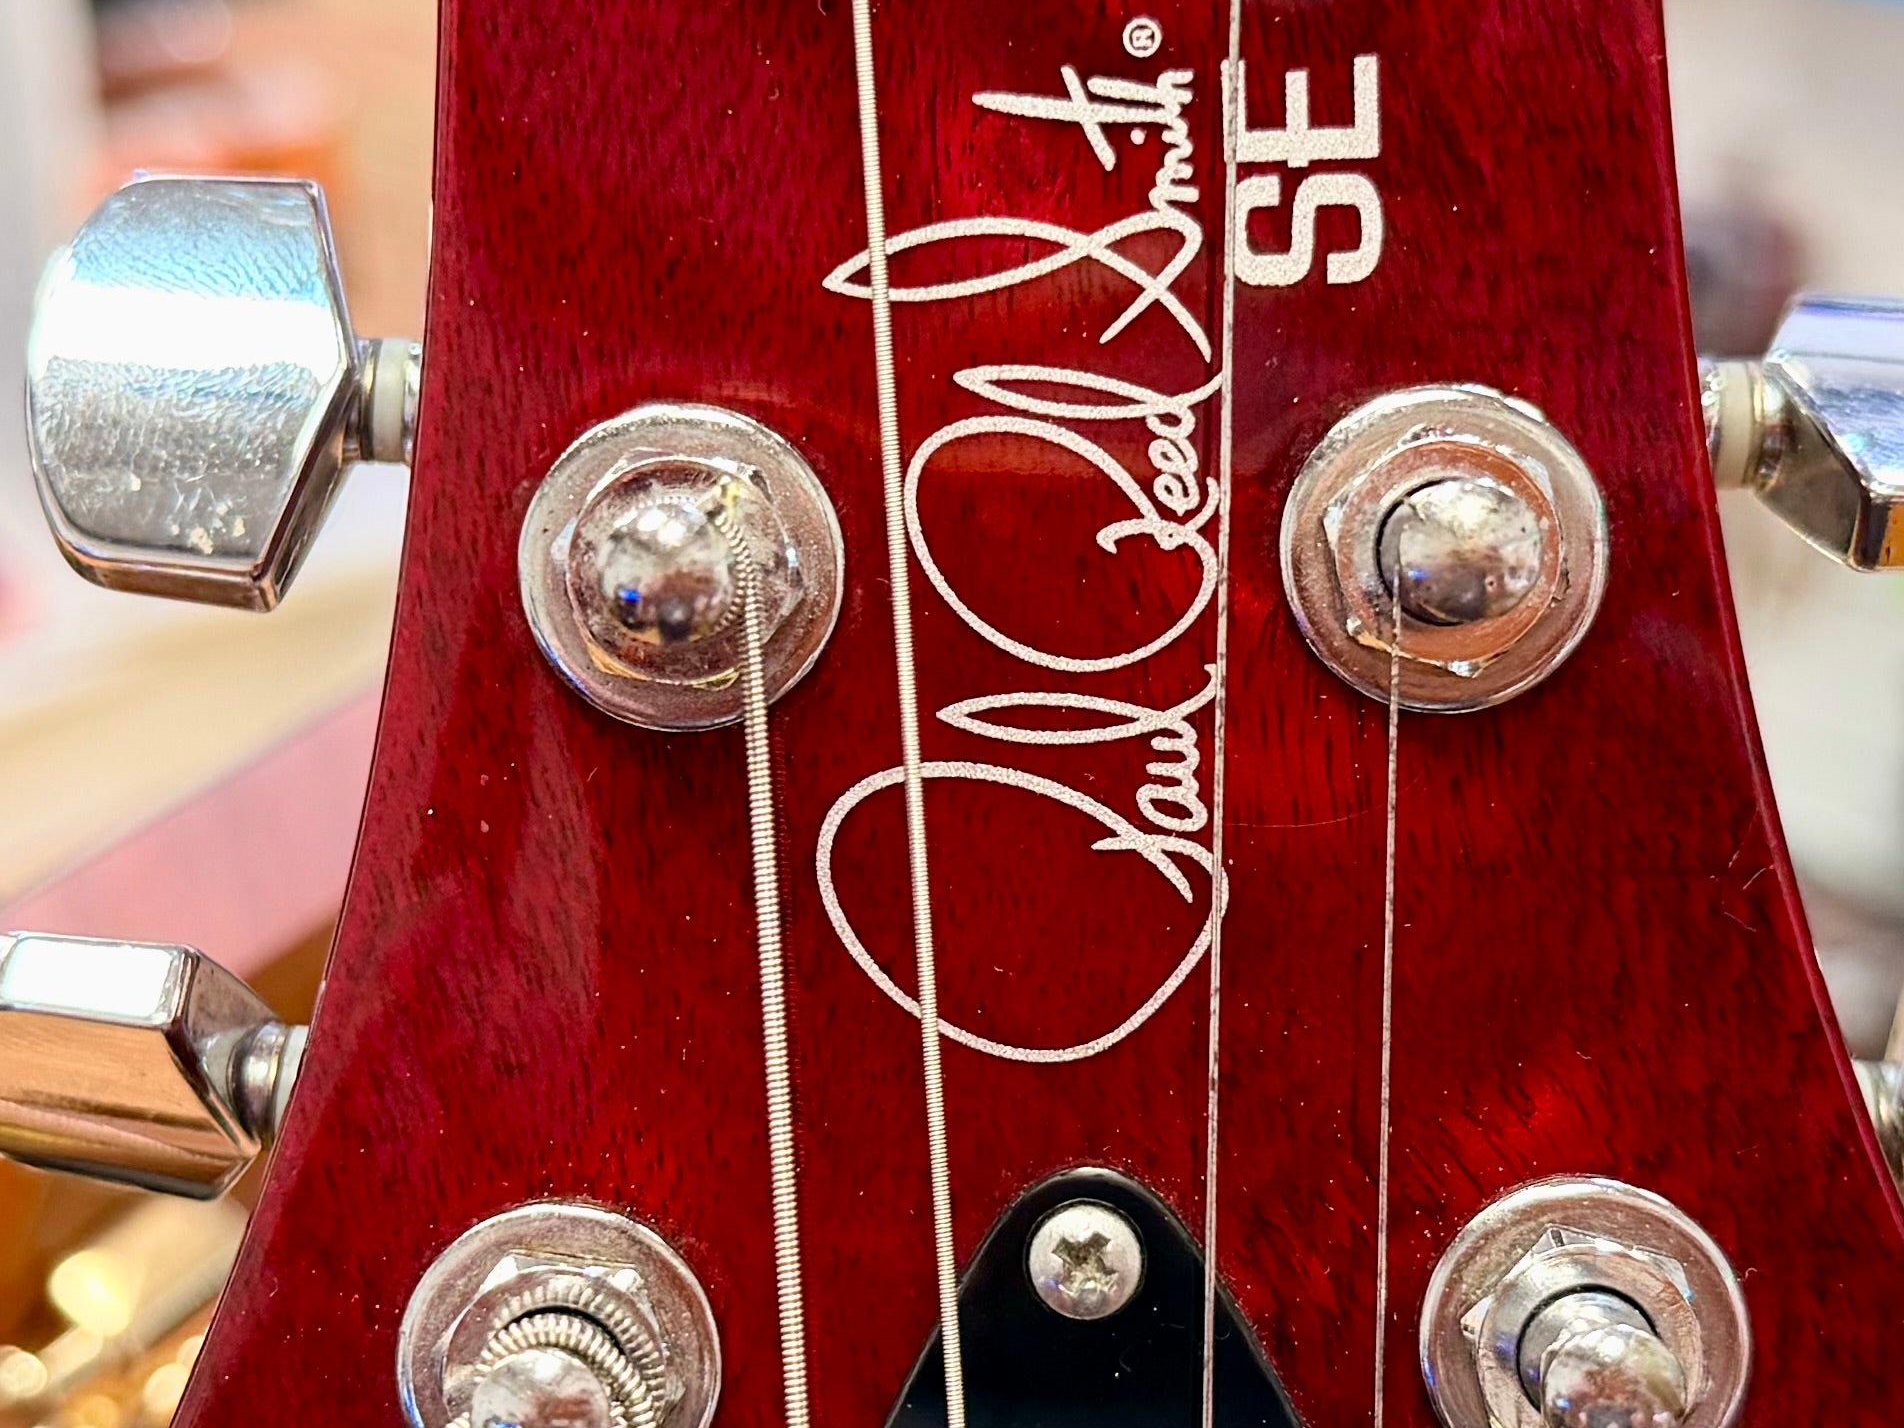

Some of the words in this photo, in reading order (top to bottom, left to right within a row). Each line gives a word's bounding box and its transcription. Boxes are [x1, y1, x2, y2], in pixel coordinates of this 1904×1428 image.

[1220, 52, 1384, 287] SE
[904, 364, 1224, 673] Reed
[815, 663, 1230, 1063] Paul
